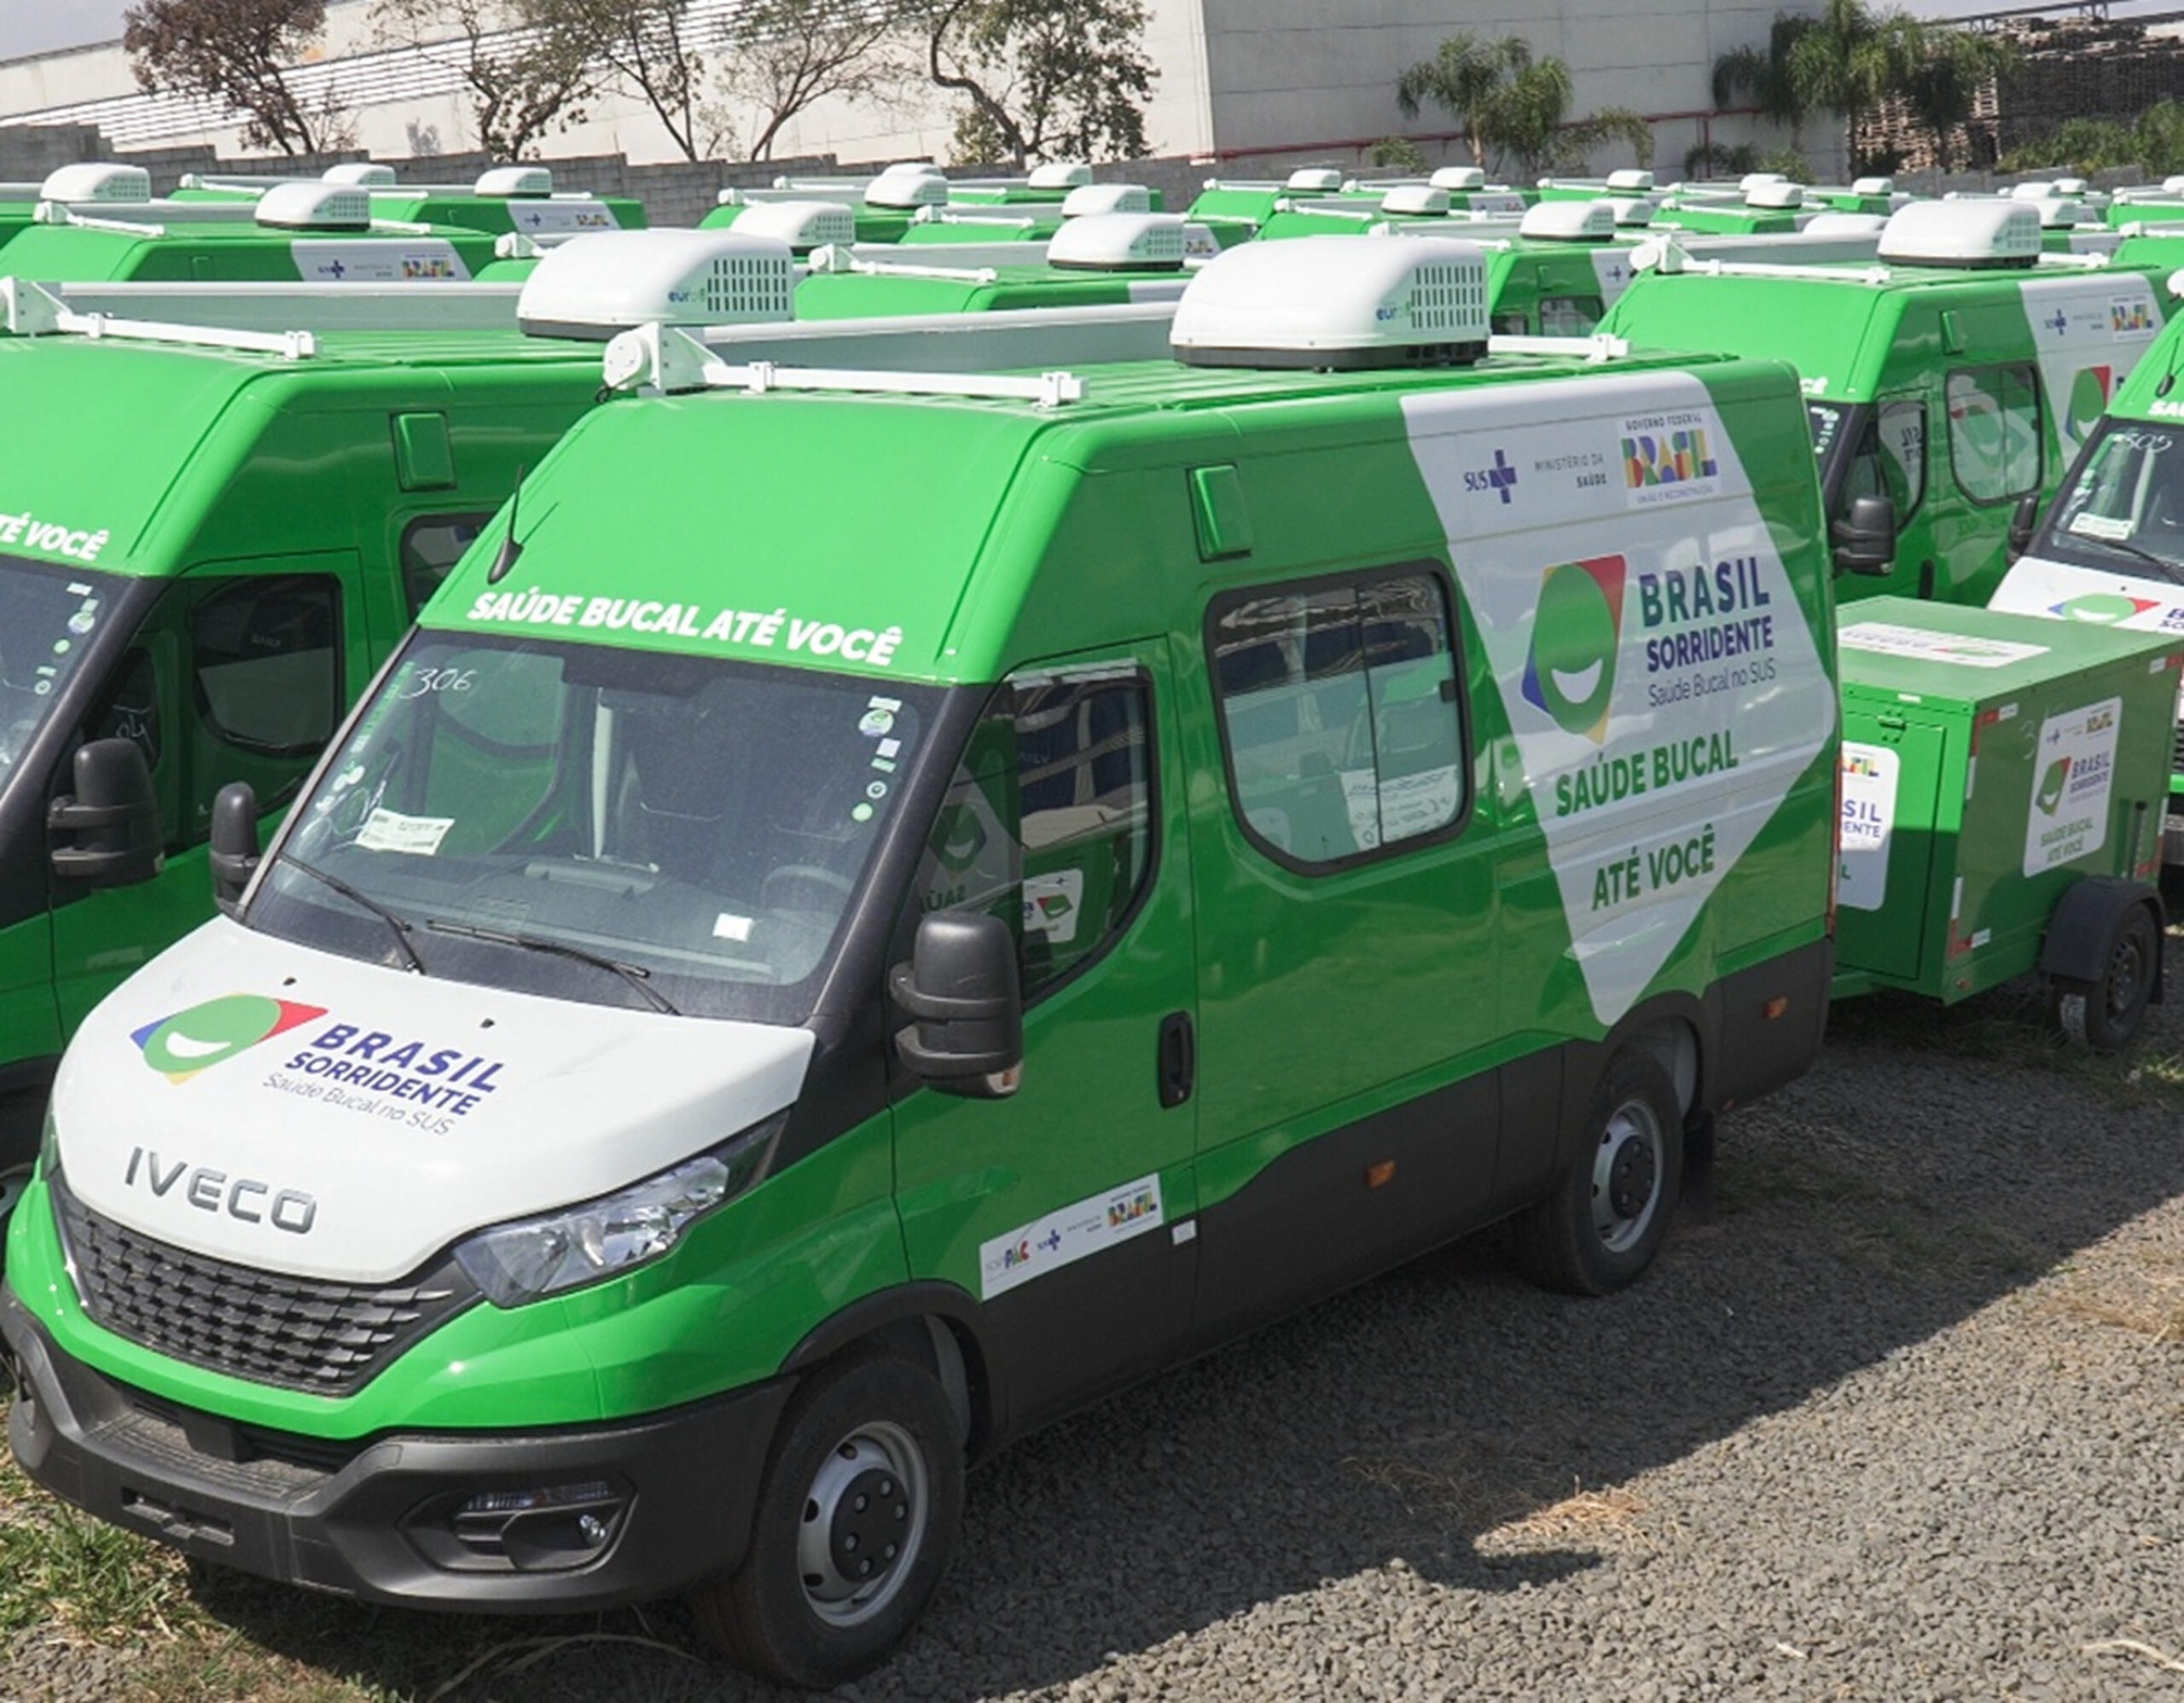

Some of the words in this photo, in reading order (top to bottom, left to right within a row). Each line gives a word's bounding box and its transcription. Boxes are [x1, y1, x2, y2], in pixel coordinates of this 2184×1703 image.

[1464, 470, 1489, 491] SUS
[1535, 454, 1589, 472] MINISTÉRIO
[1591, 453, 1605, 466] DA
[1577, 473, 1608, 489] SAÚDE
[1621, 428, 1718, 488] BRASIL
[24, 520, 110, 561] VOCÊ
[1639, 556, 1770, 627] BRASIL
[467, 586, 583, 626] SAÚDE
[579, 597, 700, 636] BUCAL
[702, 608, 787, 647] ATÉ
[786, 618, 903, 666] VOCÊ
[1647, 615, 1774, 672] SORRIDENTE
[398, 668, 479, 699] 306
[1649, 677, 1690, 706] Saúde
[1693, 666, 1729, 696] Bucal
[1732, 669, 1747, 689] no
[1750, 657, 1775, 683] SUS
[1556, 751, 1647, 817] SAÚDE
[1653, 729, 1739, 788] BUCAL
[1592, 846, 1641, 911] ATÉ
[1648, 822, 1715, 890] VOCÊ
[285, 1051, 481, 1116] SORRIDENTE
[310, 1023, 504, 1093] BRASIL
[263, 1072, 323, 1101] Saúde
[322, 1086, 376, 1114] Bucal
[377, 1104, 406, 1121] no
[405, 1109, 456, 1136] SUS
[125, 1146, 317, 1234] IVECO
